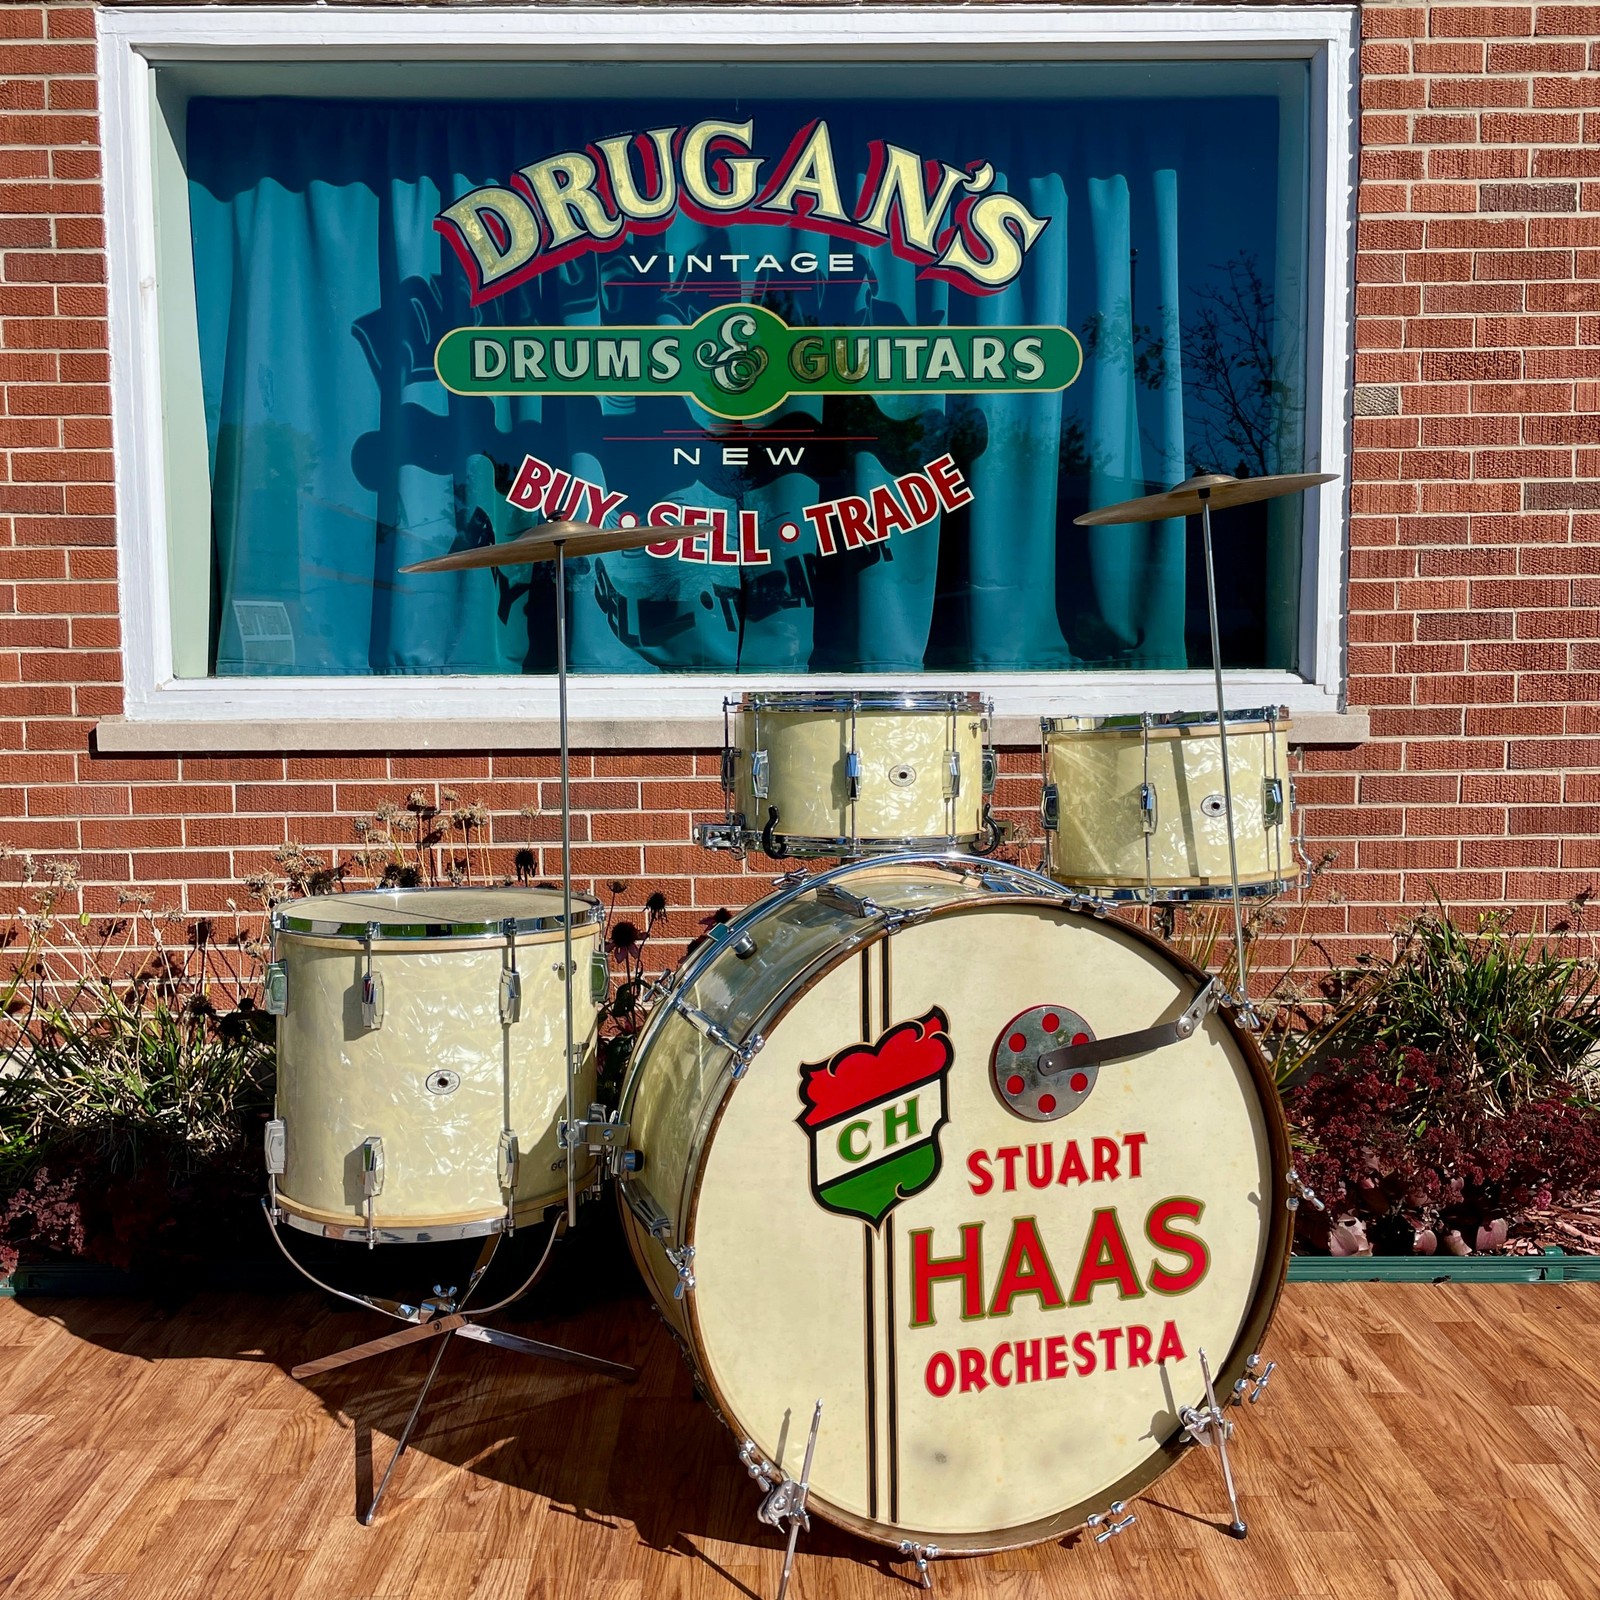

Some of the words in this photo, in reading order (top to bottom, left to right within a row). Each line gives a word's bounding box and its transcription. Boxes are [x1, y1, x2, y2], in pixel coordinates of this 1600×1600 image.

[436, 118, 1048, 298] DRUGAN'S
[630, 253, 854, 273] VINTAGE
[471, 337, 681, 381] DRUMS
[697, 313, 768, 392] &
[790, 336, 1045, 382] GUITARS
[673, 447, 805, 466] NEW
[506, 454, 628, 530] BUY
[645, 501, 772, 566] SELL
[803, 453, 975, 556] TRADE
[966, 1132, 1148, 1195] STUART
[908, 1195, 1211, 1329] HAAS
[925, 1320, 1187, 1398] ORCHESTRA
